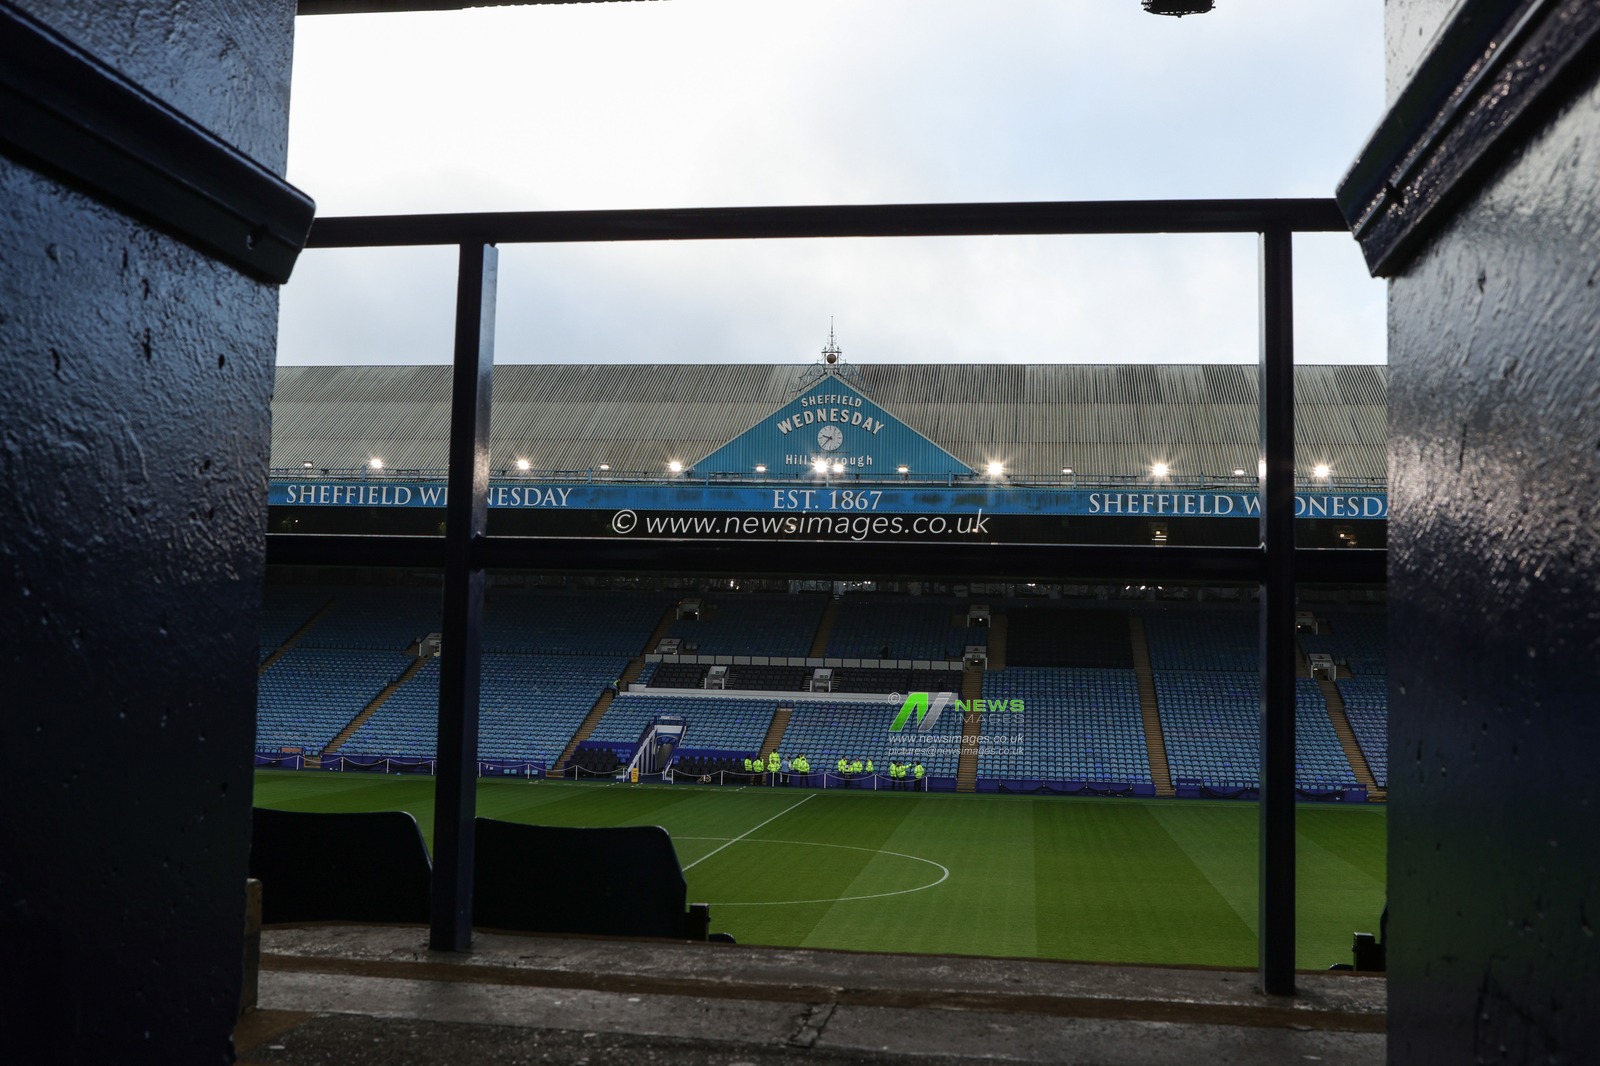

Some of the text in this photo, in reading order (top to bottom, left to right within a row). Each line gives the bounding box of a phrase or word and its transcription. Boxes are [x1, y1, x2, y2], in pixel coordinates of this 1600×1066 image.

[801, 395, 862, 407] SHEFFIELD
[777, 408, 885, 435] WEDNESDAY
[785, 454, 873, 468] Hillsorough
[286, 485, 573, 507] SHEFFIELD WESDAY
[773, 489, 883, 510] EST. 1867
[1088, 493, 1234, 515] SHEFFIELD
